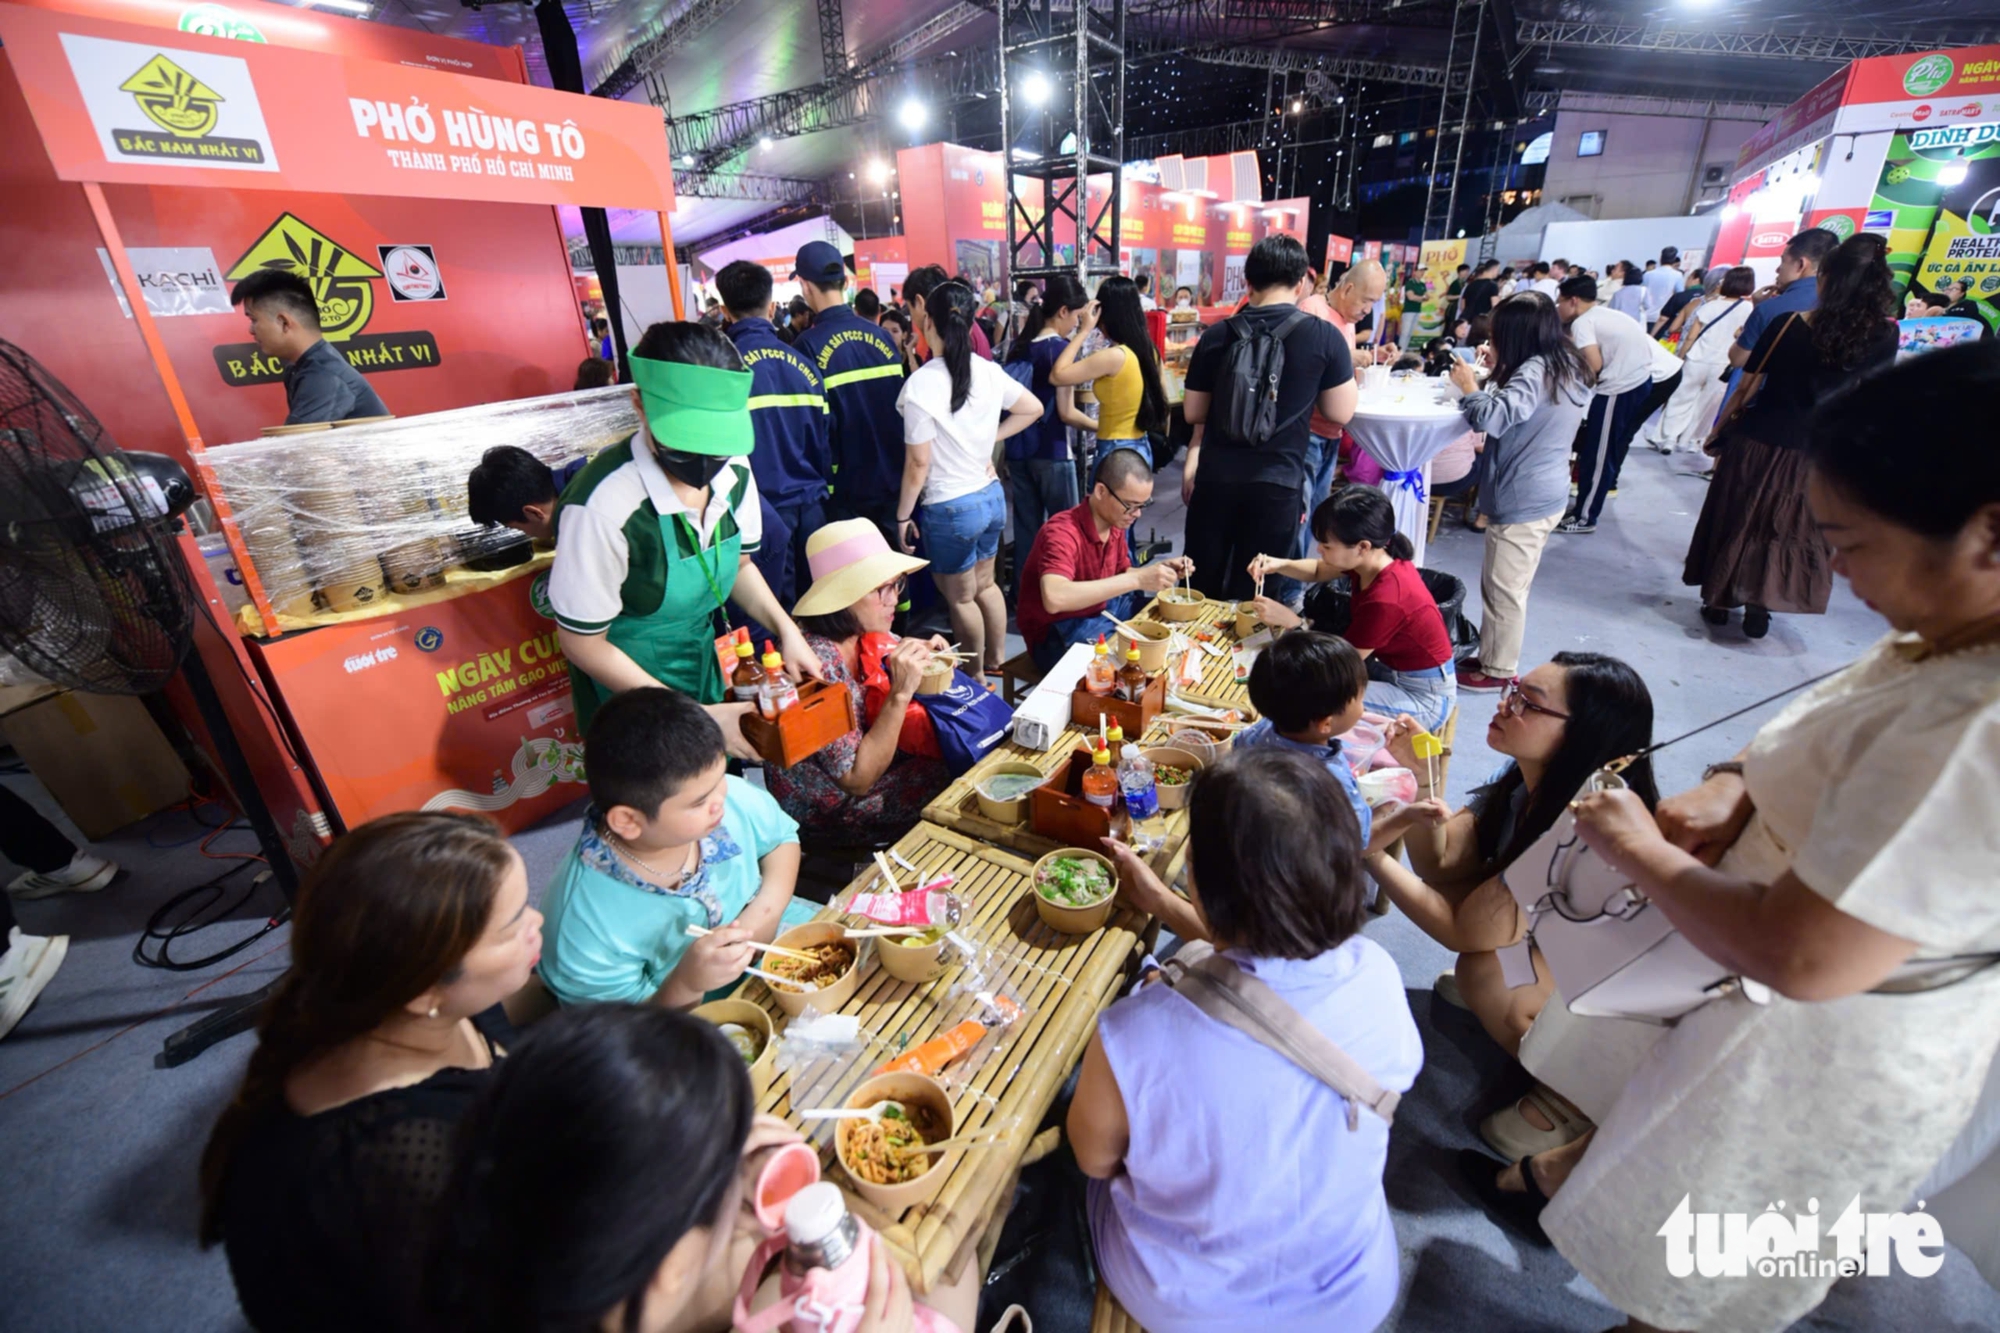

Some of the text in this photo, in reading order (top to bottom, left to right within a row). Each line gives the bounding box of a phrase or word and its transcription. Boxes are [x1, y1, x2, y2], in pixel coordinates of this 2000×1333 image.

[348, 96, 586, 160] PHỞ HÙNG TÔ
[159, 141, 196, 155] NAM
[242, 147, 259, 162] VỊ
[387, 147, 574, 182] THÀNH PHỐ HỒ CHÍ MINH
[1426, 246, 1459, 262] PHỞ
[1947, 248, 2000, 258] PROTEI
[227, 341, 432, 378] BẮC NHẤT VỊ
[829, 333, 845, 349] SÁT
[842, 330, 863, 341] PCCC
[864, 332, 874, 345] VÀ
[874, 338, 895, 360] CNCH
[760, 348, 785, 360] PCCC
[798, 362, 819, 387] CNCH
[436, 648, 512, 696] NGÀY
